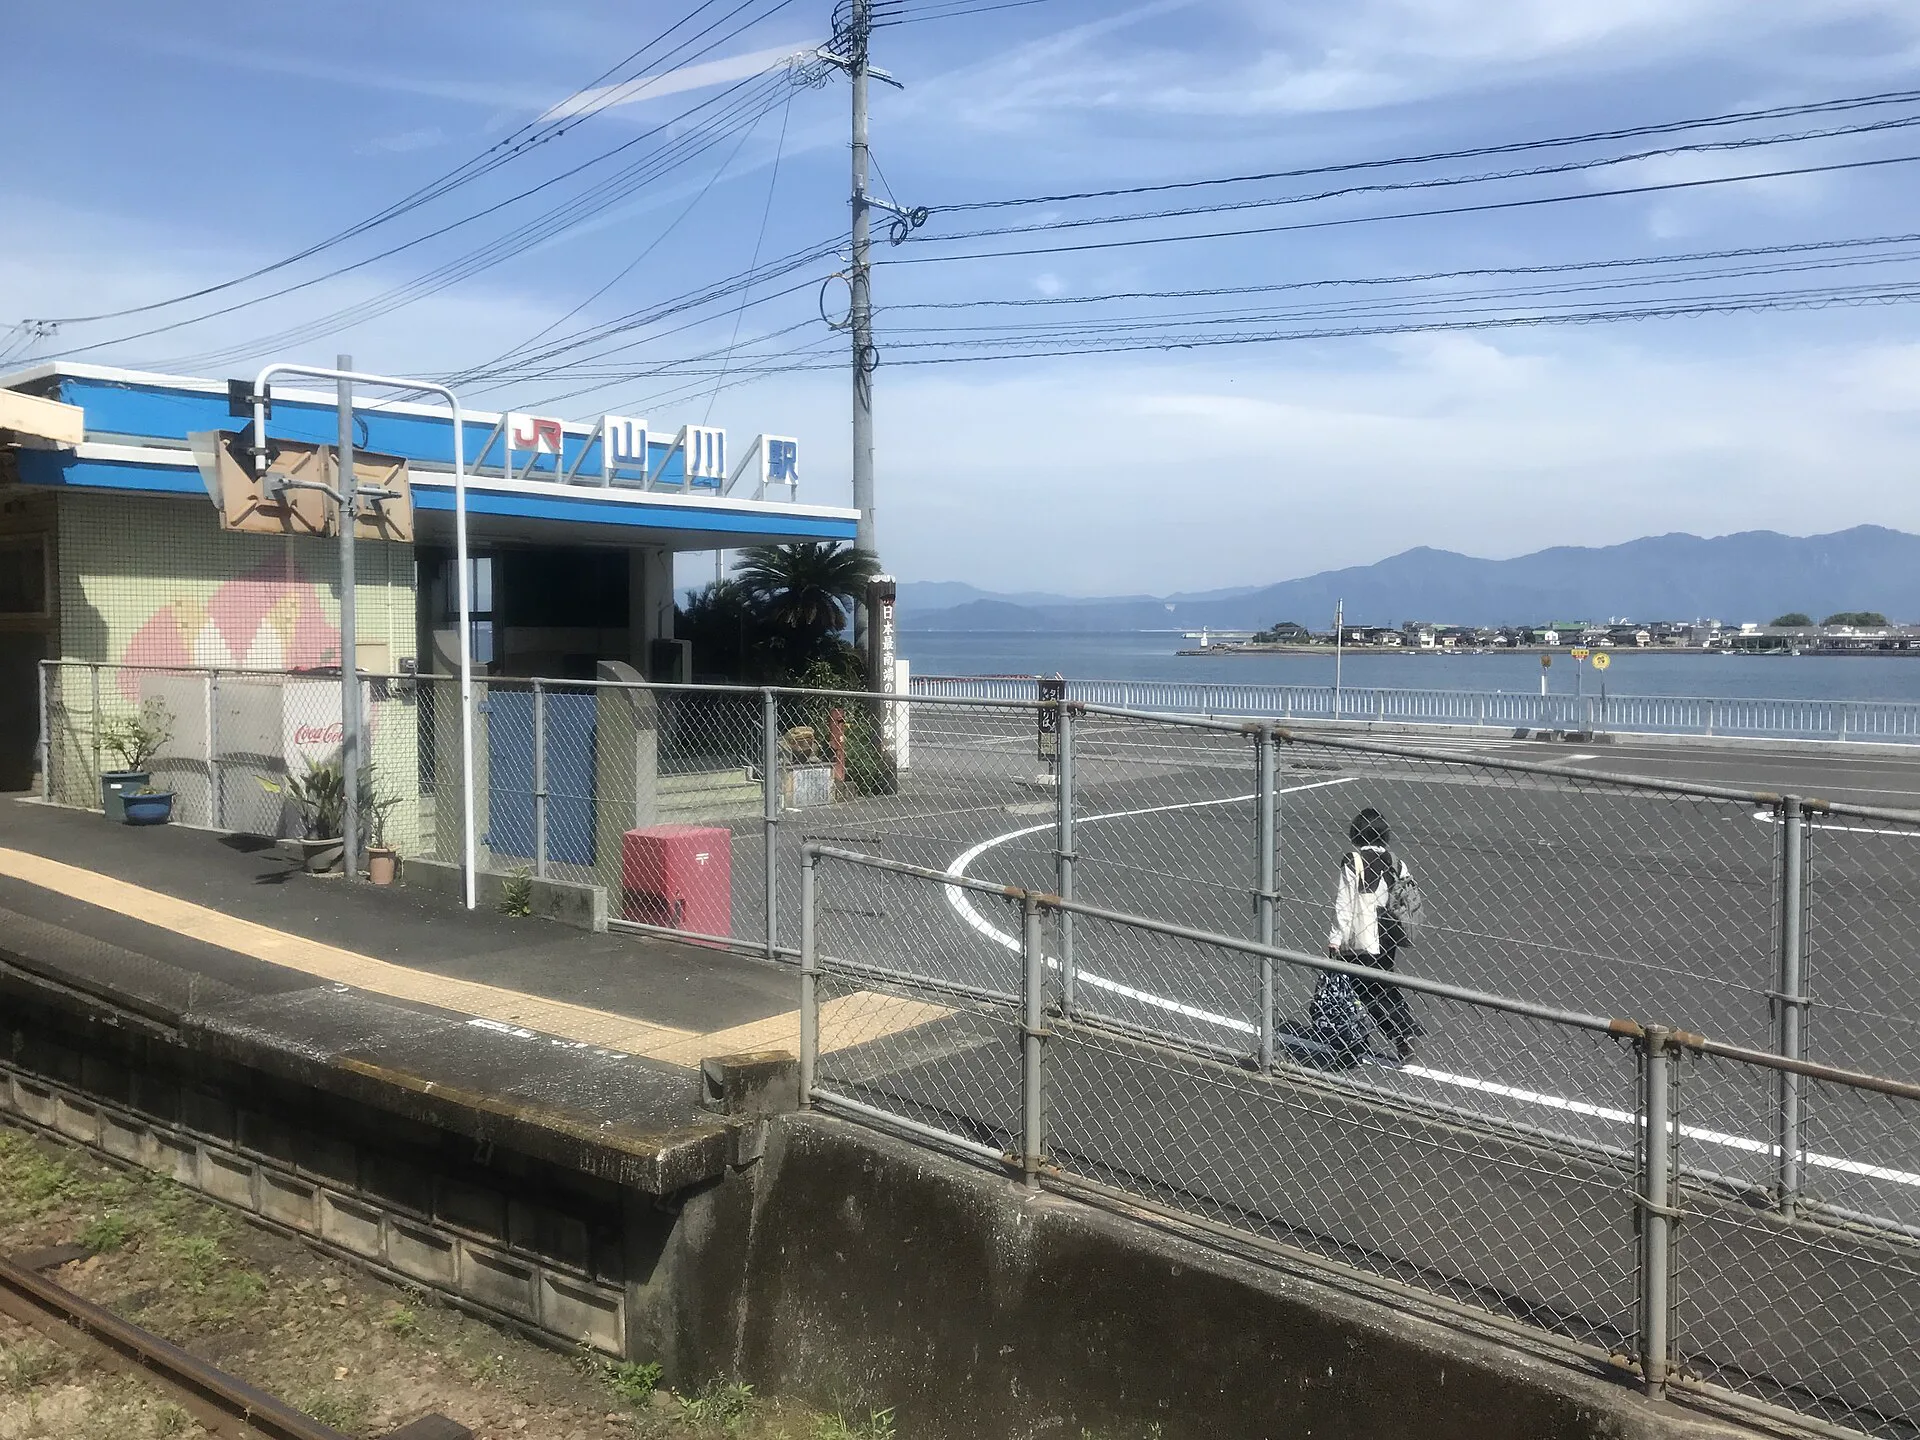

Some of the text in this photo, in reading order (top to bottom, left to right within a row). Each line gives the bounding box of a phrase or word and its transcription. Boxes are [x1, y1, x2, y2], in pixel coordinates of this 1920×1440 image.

[514, 418, 798, 481] JR 山川駅
[294, 722, 344, 745] Coca-Col
